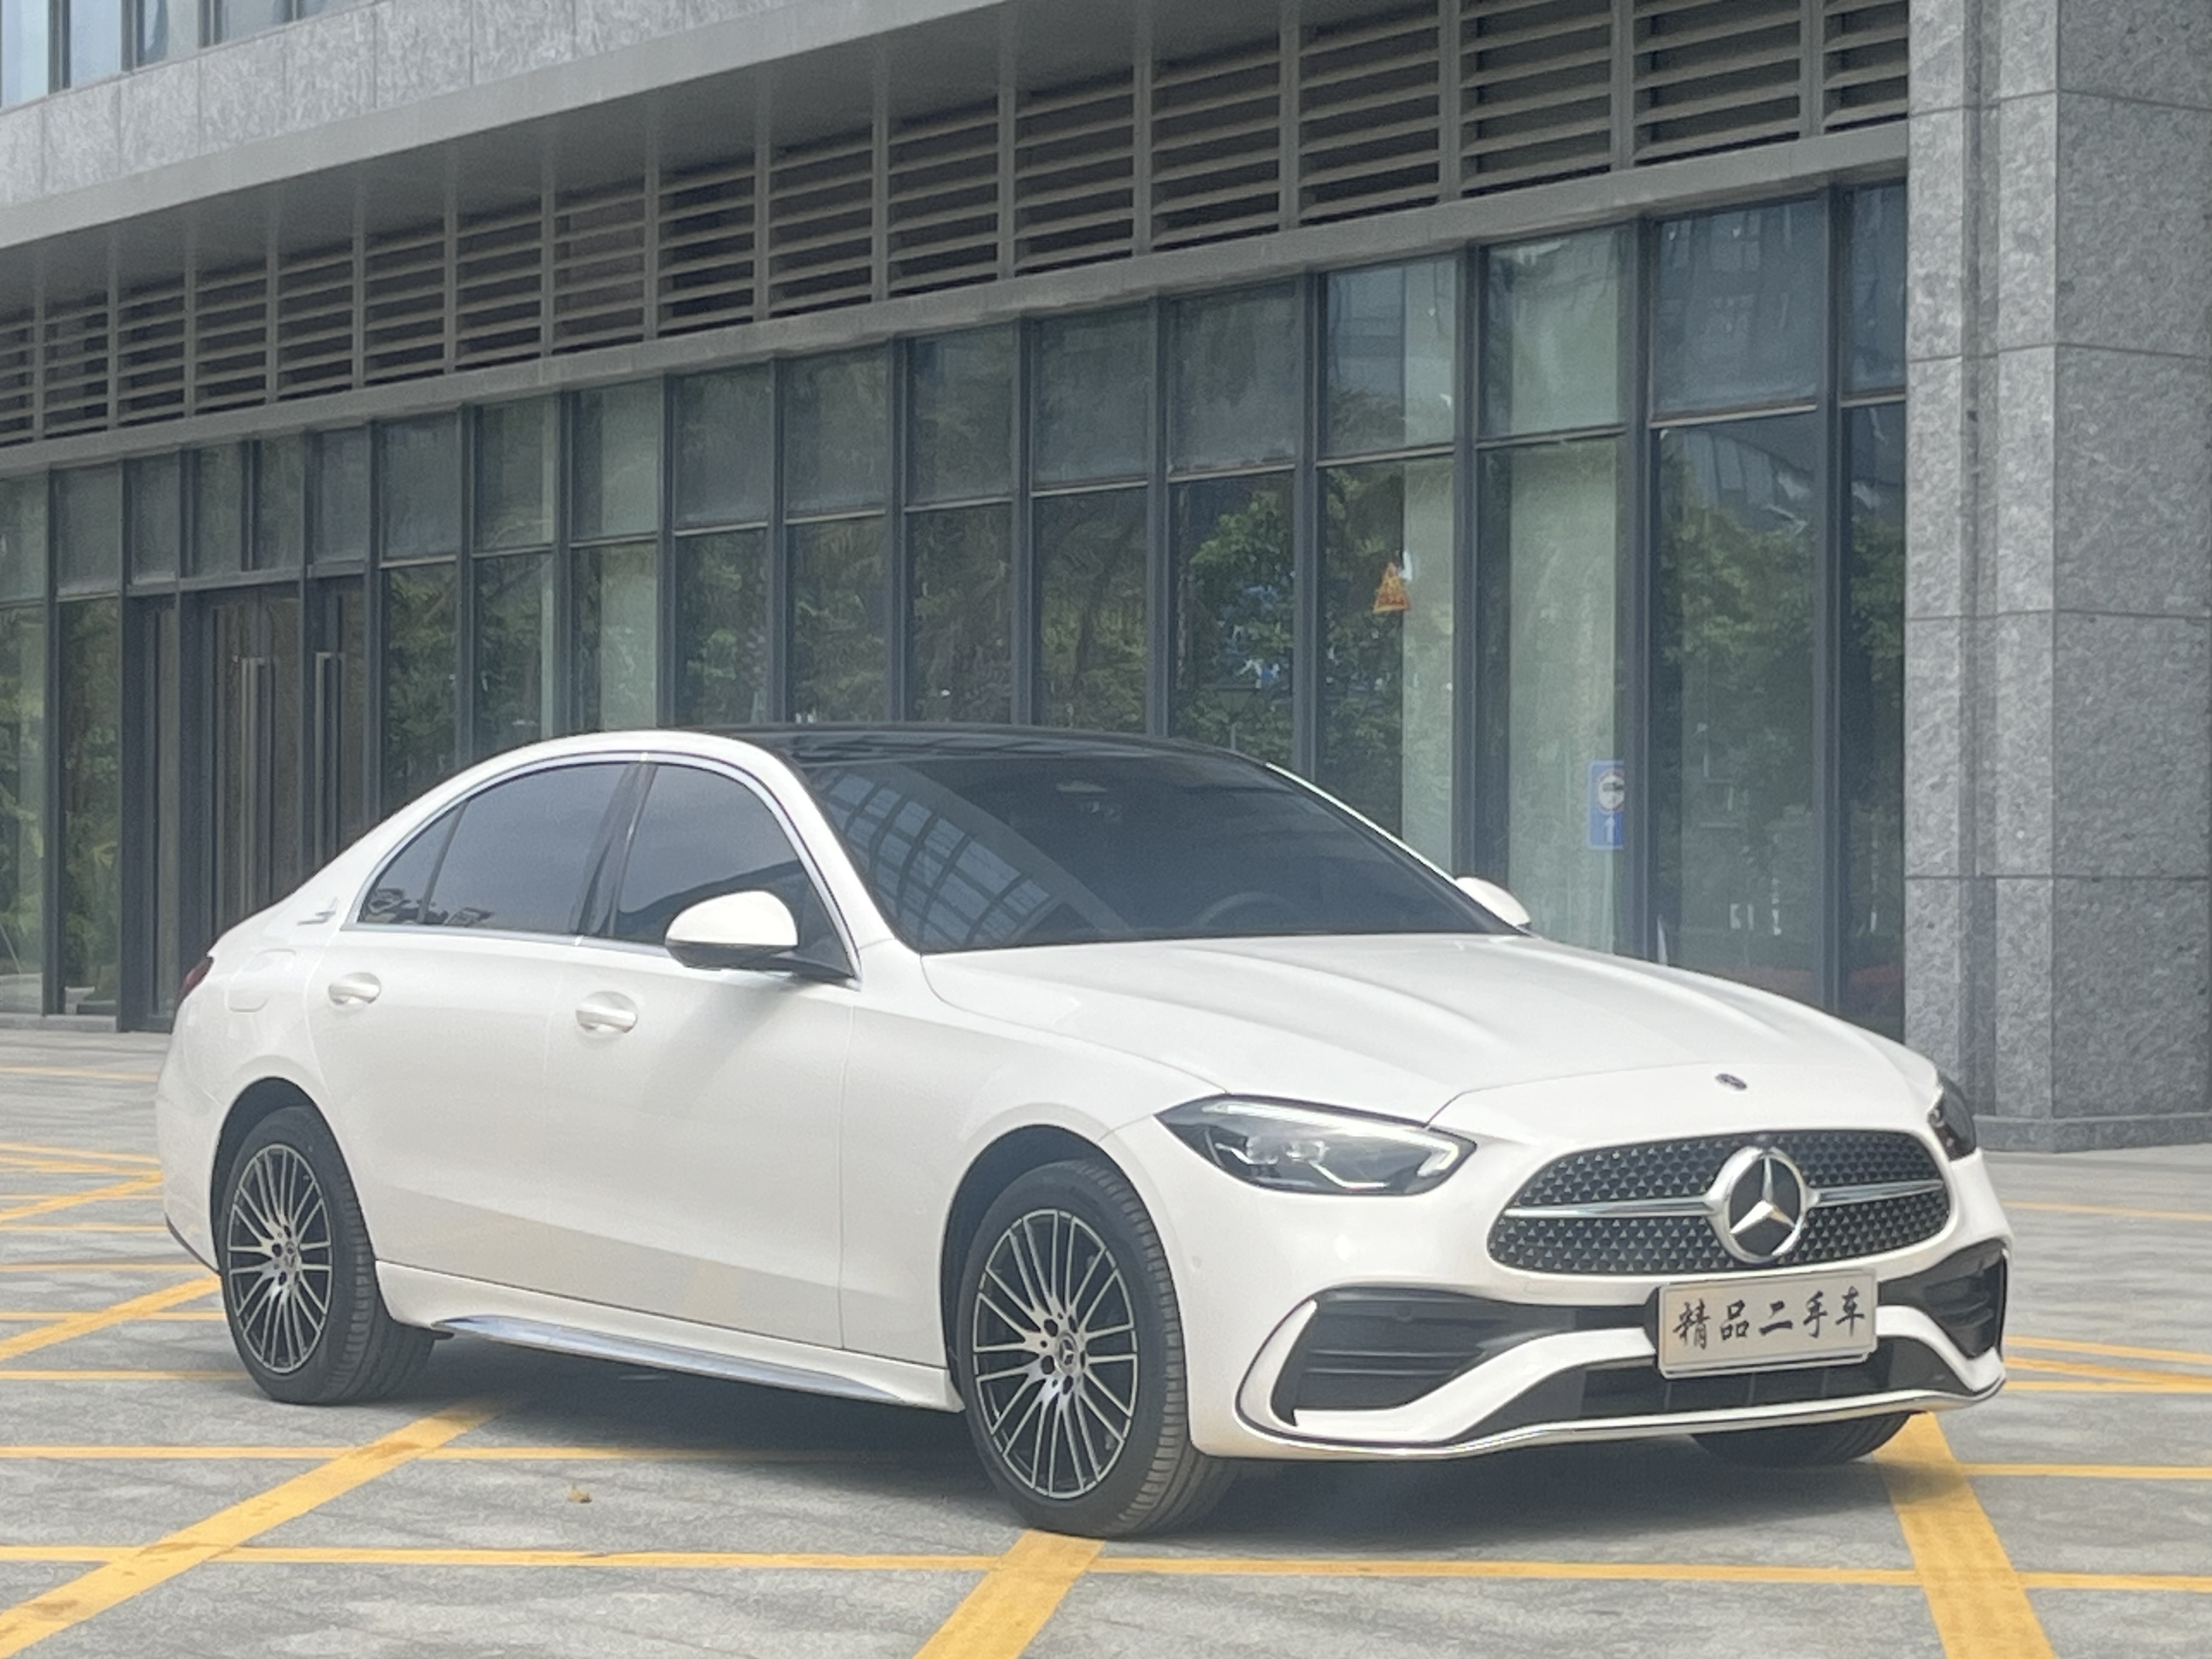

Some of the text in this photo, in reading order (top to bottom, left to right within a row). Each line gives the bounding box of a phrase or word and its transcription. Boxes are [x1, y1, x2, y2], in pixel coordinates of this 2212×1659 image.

[1673, 1286, 1865, 1350] 精品二手车
